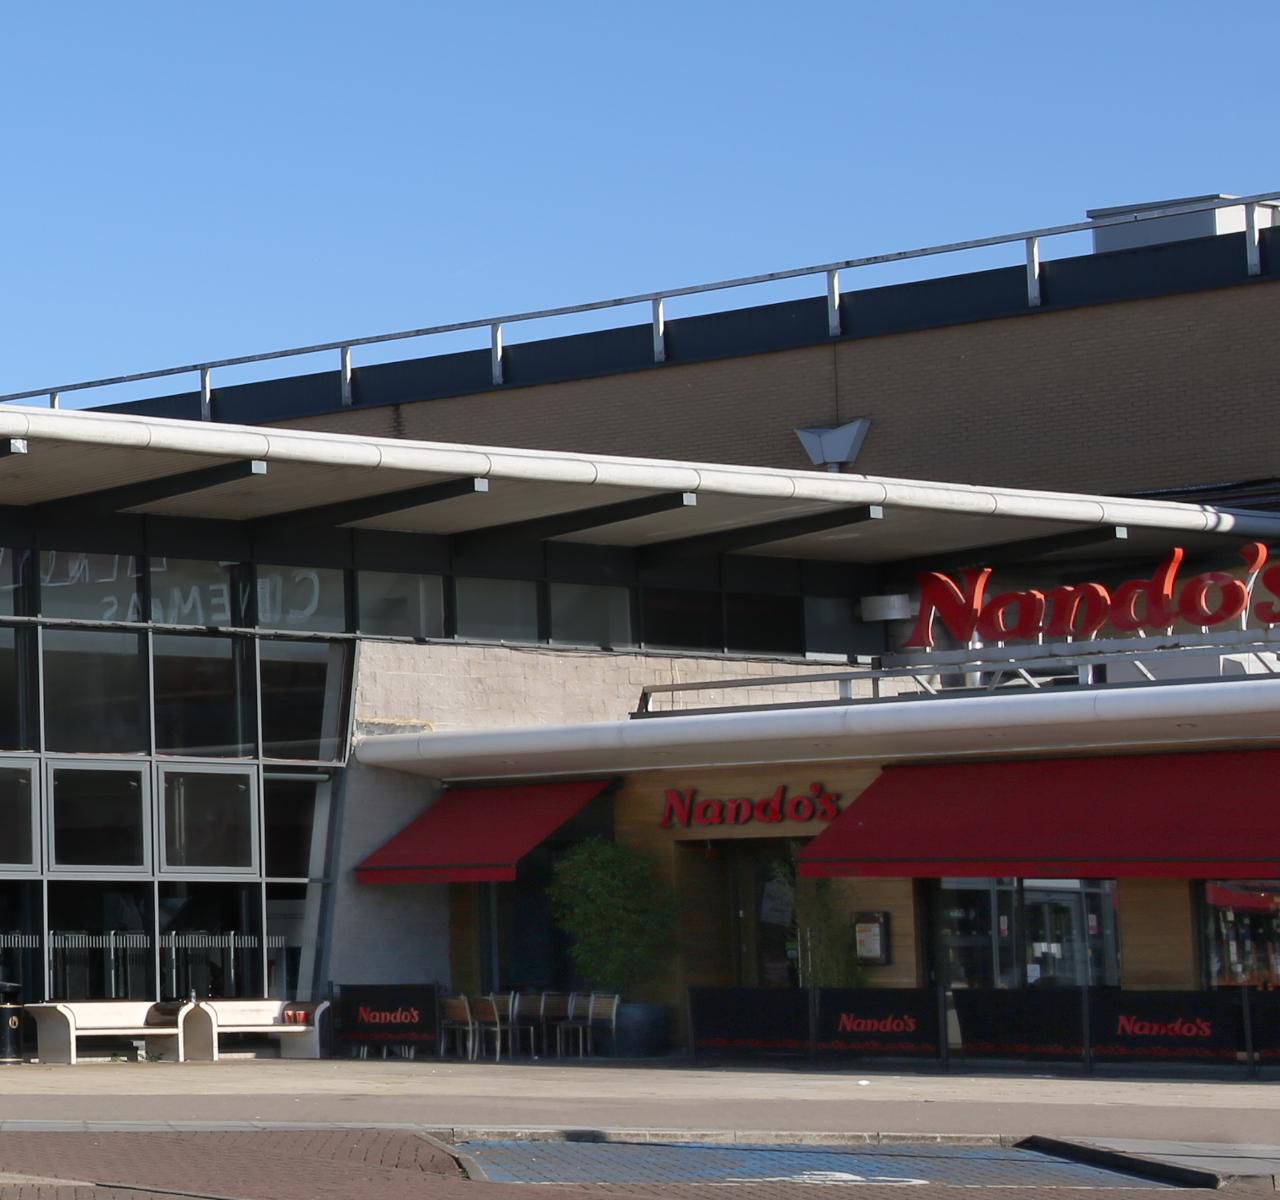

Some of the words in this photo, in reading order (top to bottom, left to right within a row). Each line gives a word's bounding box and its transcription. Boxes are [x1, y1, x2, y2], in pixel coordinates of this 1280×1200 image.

[660, 782, 841, 829] Nando's
[357, 1007, 420, 1024] Nando's
[838, 1012, 917, 1034] Nando's
[1115, 1014, 1213, 1038] Nando's
